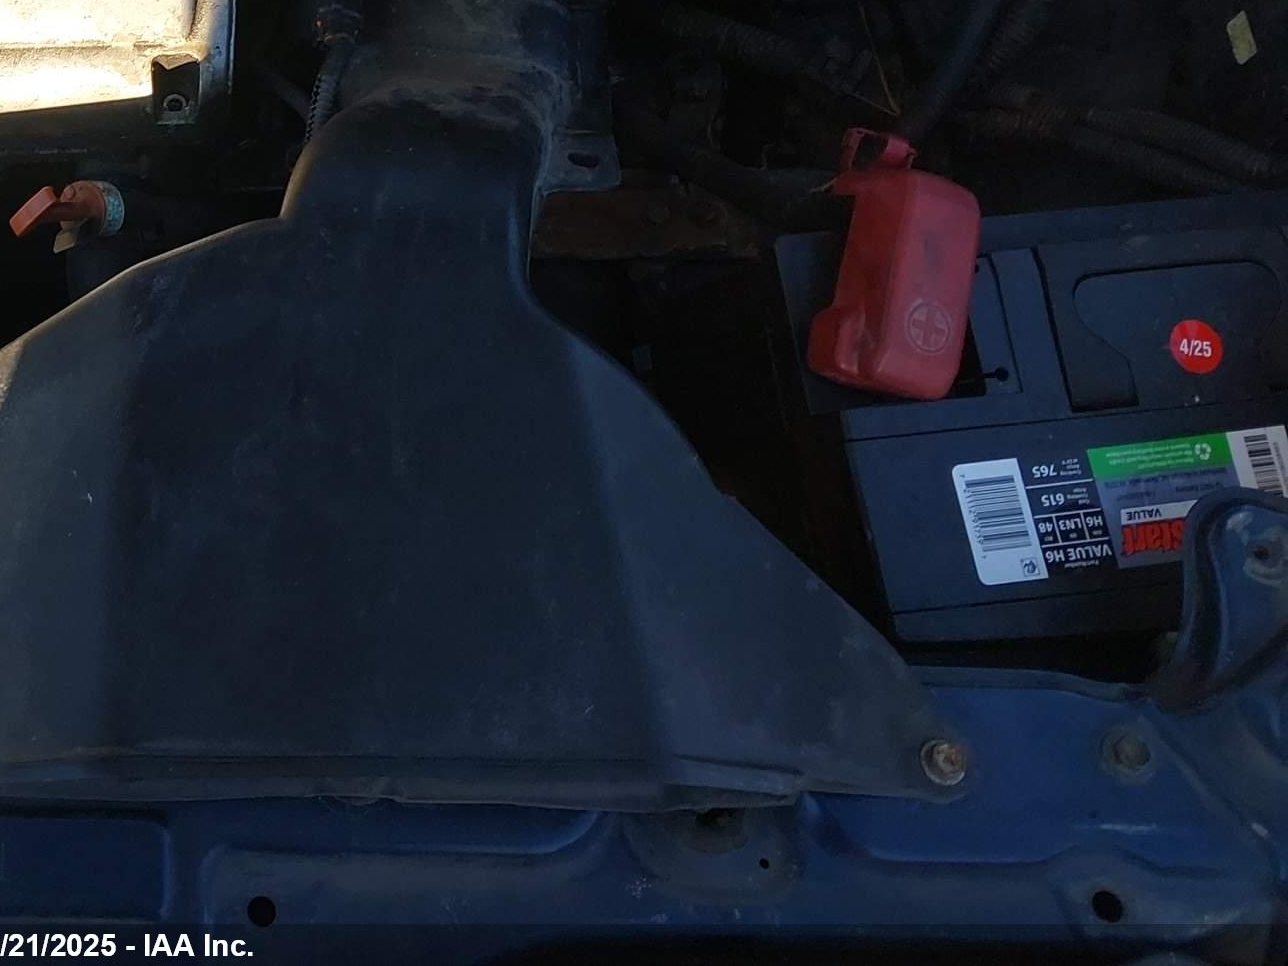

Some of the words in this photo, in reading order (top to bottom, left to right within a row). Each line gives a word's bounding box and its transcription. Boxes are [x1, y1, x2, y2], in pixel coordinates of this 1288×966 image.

[1179, 338, 1212, 358] 4/25
[1031, 463, 1058, 478] 765
[1040, 492, 1065, 507] 615
[1085, 515, 1103, 528] H6
[1126, 508, 1161, 520] VALUE
[1038, 521, 1053, 534] 48
[1058, 517, 1082, 531] LN3
[1045, 549, 1064, 564] H6
[1067, 542, 1113, 562] VALUE
